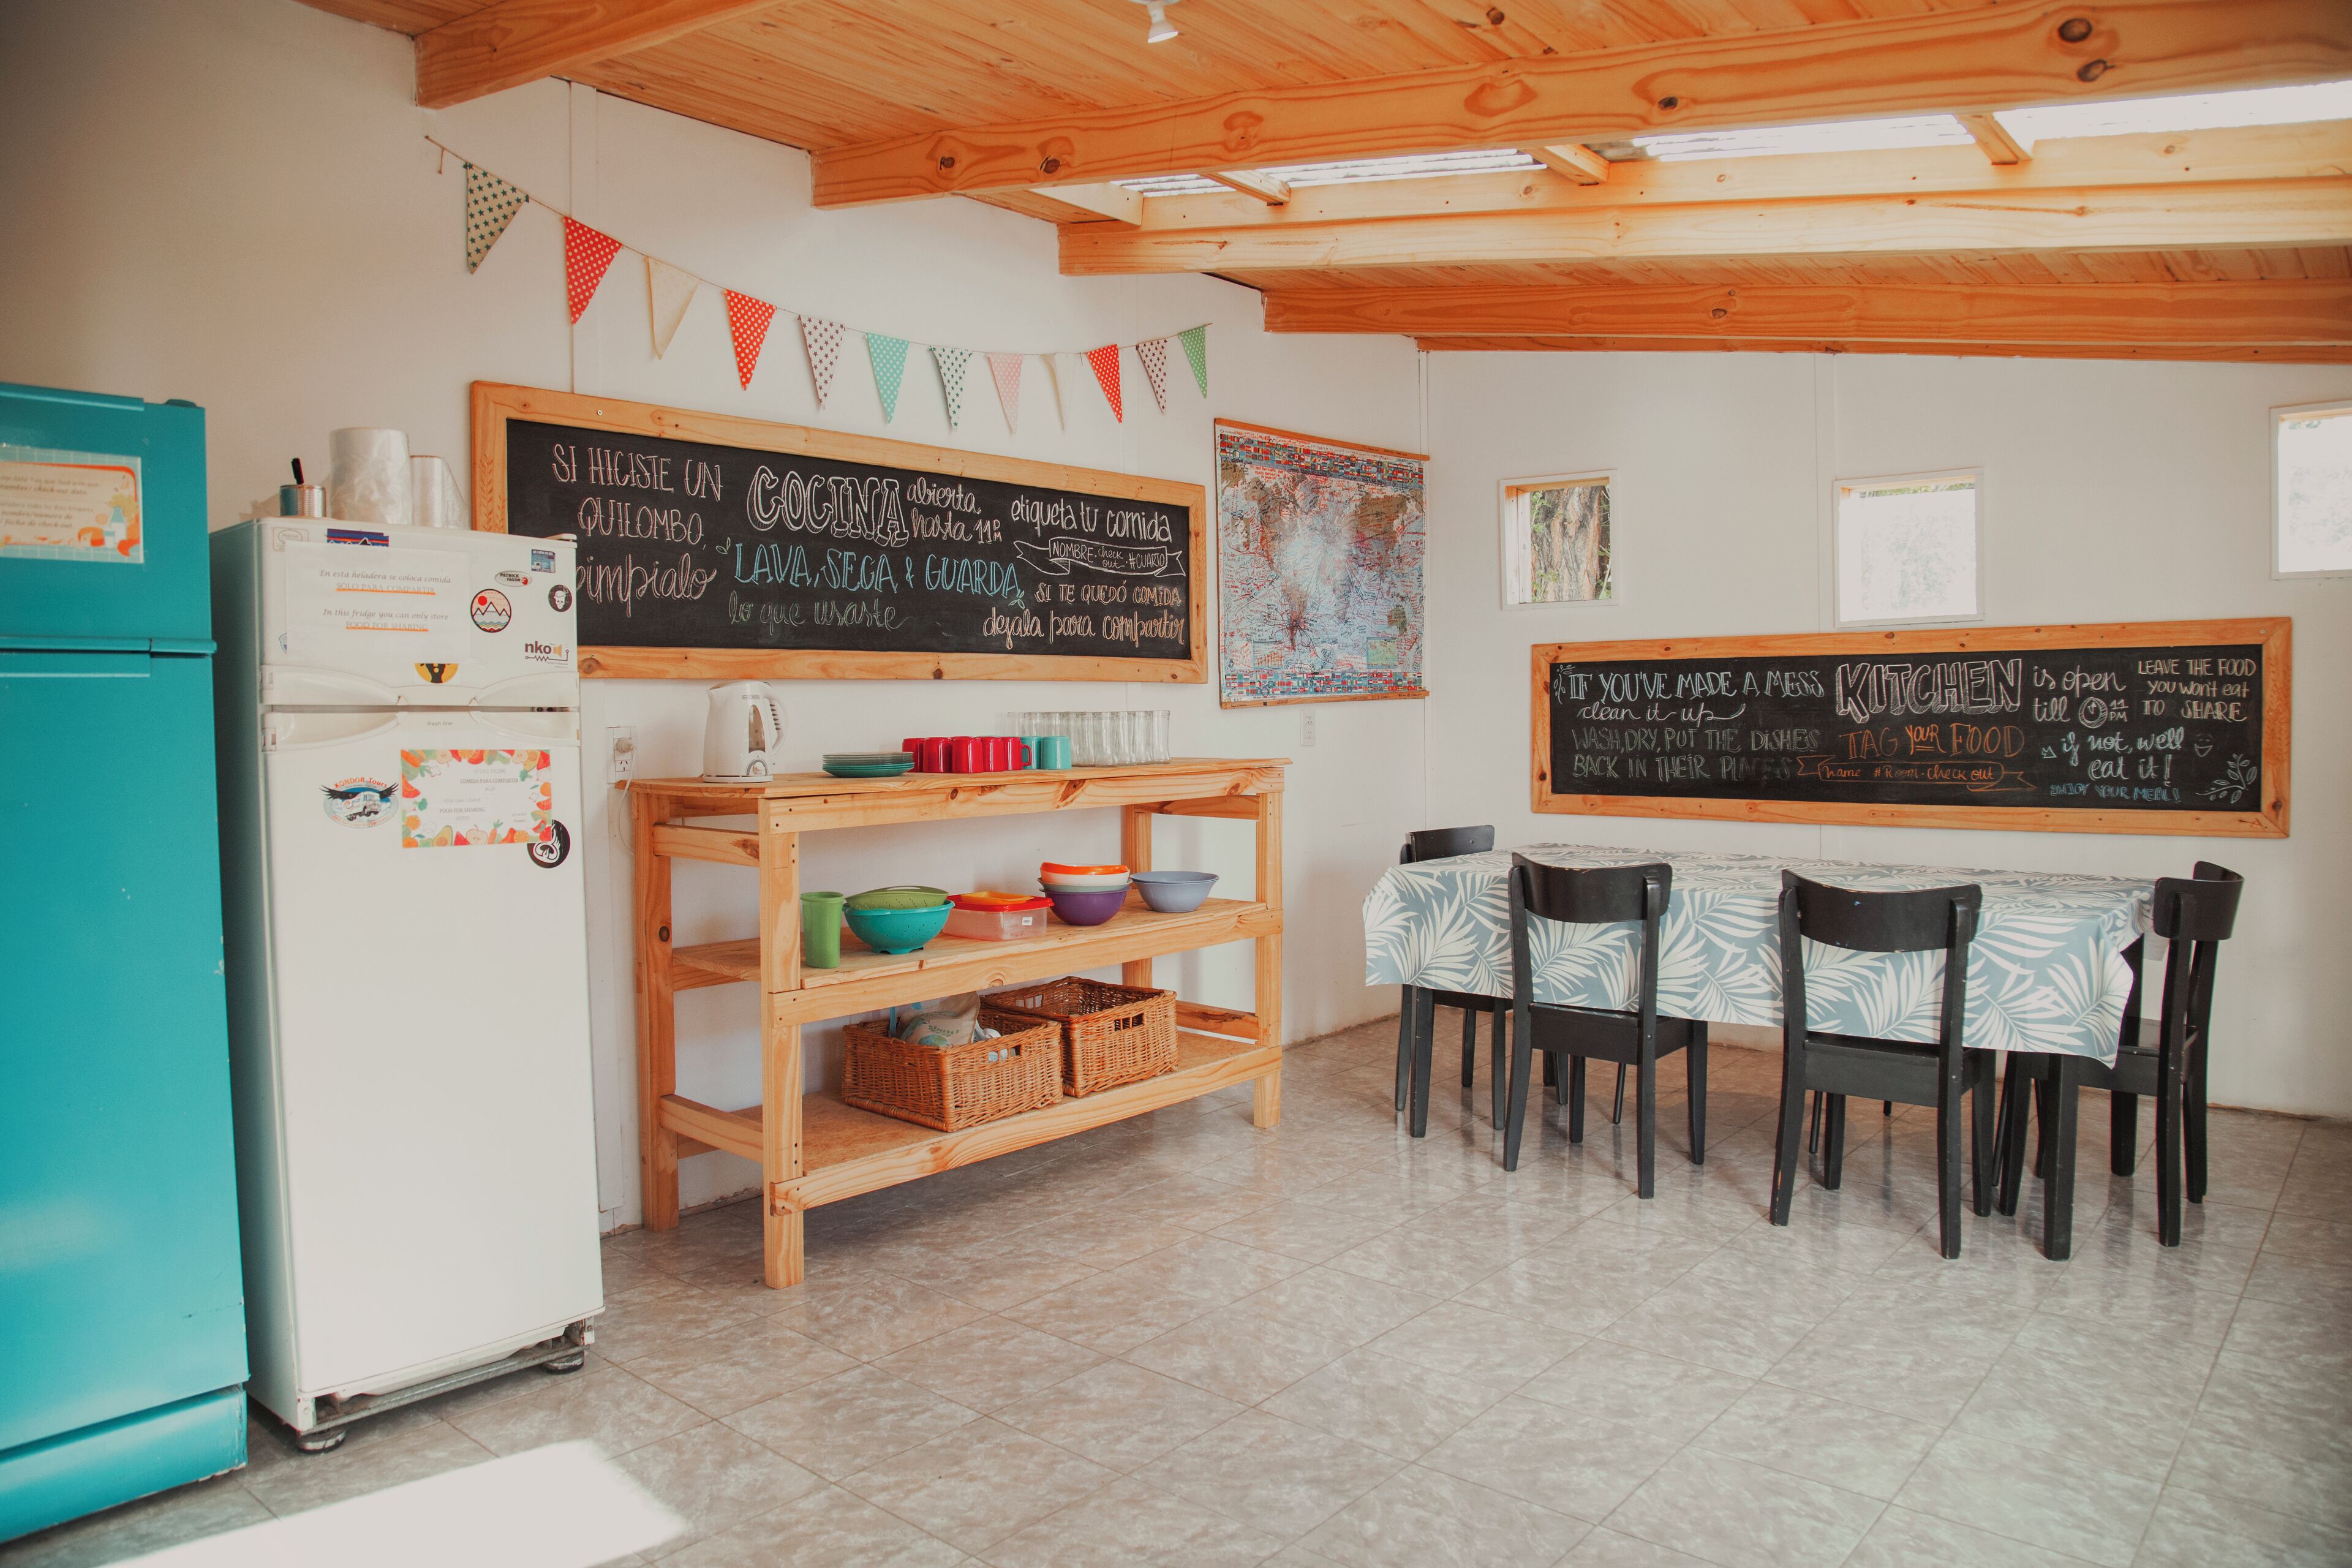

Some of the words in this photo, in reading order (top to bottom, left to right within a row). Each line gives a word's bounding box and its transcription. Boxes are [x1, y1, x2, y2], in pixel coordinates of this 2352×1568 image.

[552, 443, 577, 483] SI
[588, 447, 674, 494] HICISTE
[684, 459, 723, 502] UN
[747, 466, 909, 548] COCINA
[907, 477, 981, 514] abierta
[578, 497, 706, 551] QUILOMBO,
[911, 507, 973, 541] hasta
[1011, 494, 1077, 538] etiqueta
[1080, 501, 1099, 532] tu
[1106, 510, 1172, 543] comida
[352, 570, 386, 580] heladera
[424, 575, 451, 583] comida
[734, 543, 820, 588] LAVA,
[905, 556, 914, 589] &
[925, 554, 1024, 598] GUARDA
[386, 584, 435, 594] COMPARTIR
[1034, 582, 1052, 603] SI
[1058, 584, 1075, 605] TE
[1080, 580, 1128, 606] QUEDÓ
[1133, 586, 1183, 607] COMIDA
[351, 609, 376, 619] fridge
[412, 611, 428, 620] only
[391, 622, 428, 631] SHARING
[729, 590, 753, 624] lo
[760, 602, 805, 636] que
[815, 598, 916, 631] usaste
[983, 606, 1044, 650] dejala
[1050, 610, 1096, 644] para
[1102, 609, 1185, 648] compartir
[525, 641, 551, 654] nko
[2138, 658, 2180, 674] LEAVE
[2185, 658, 2214, 676] THE
[2218, 658, 2256, 676] FOOD
[1569, 673, 1592, 699] IF
[1599, 671, 1673, 703] YOU'VE
[1675, 672, 1737, 699] MADE
[1743, 672, 1760, 696] A
[1765, 671, 1825, 698] MESS
[1836, 658, 2022, 723] KITCHEN
[2033, 666, 2056, 690] is
[2062, 665, 2127, 698] open
[2222, 683, 2250, 697] eat
[1577, 701, 1640, 720] clean
[1646, 703, 1676, 722] it
[1682, 702, 1746, 728] up
[2032, 696, 2070, 722] till
[2109, 711, 2127, 722] PM
[2142, 700, 2165, 716] TO
[2180, 700, 2248, 723] SHARE
[1665, 728, 1698, 751] PUT
[1705, 729, 1741, 753] THE
[1839, 727, 1898, 760] TAG
[1950, 723, 2025, 758] FOOD
[2060, 731, 2080, 767] if
[1572, 754, 1619, 778] BACK
[1629, 755, 1647, 778] IN
[1720, 755, 1793, 782] PLAES
[1970, 769, 1994, 780] out
[2088, 756, 2130, 781] eat
[368, 777, 388, 789] Tours
[2050, 783, 2090, 797] ENJOY
[2095, 783, 2130, 800] YOUR
